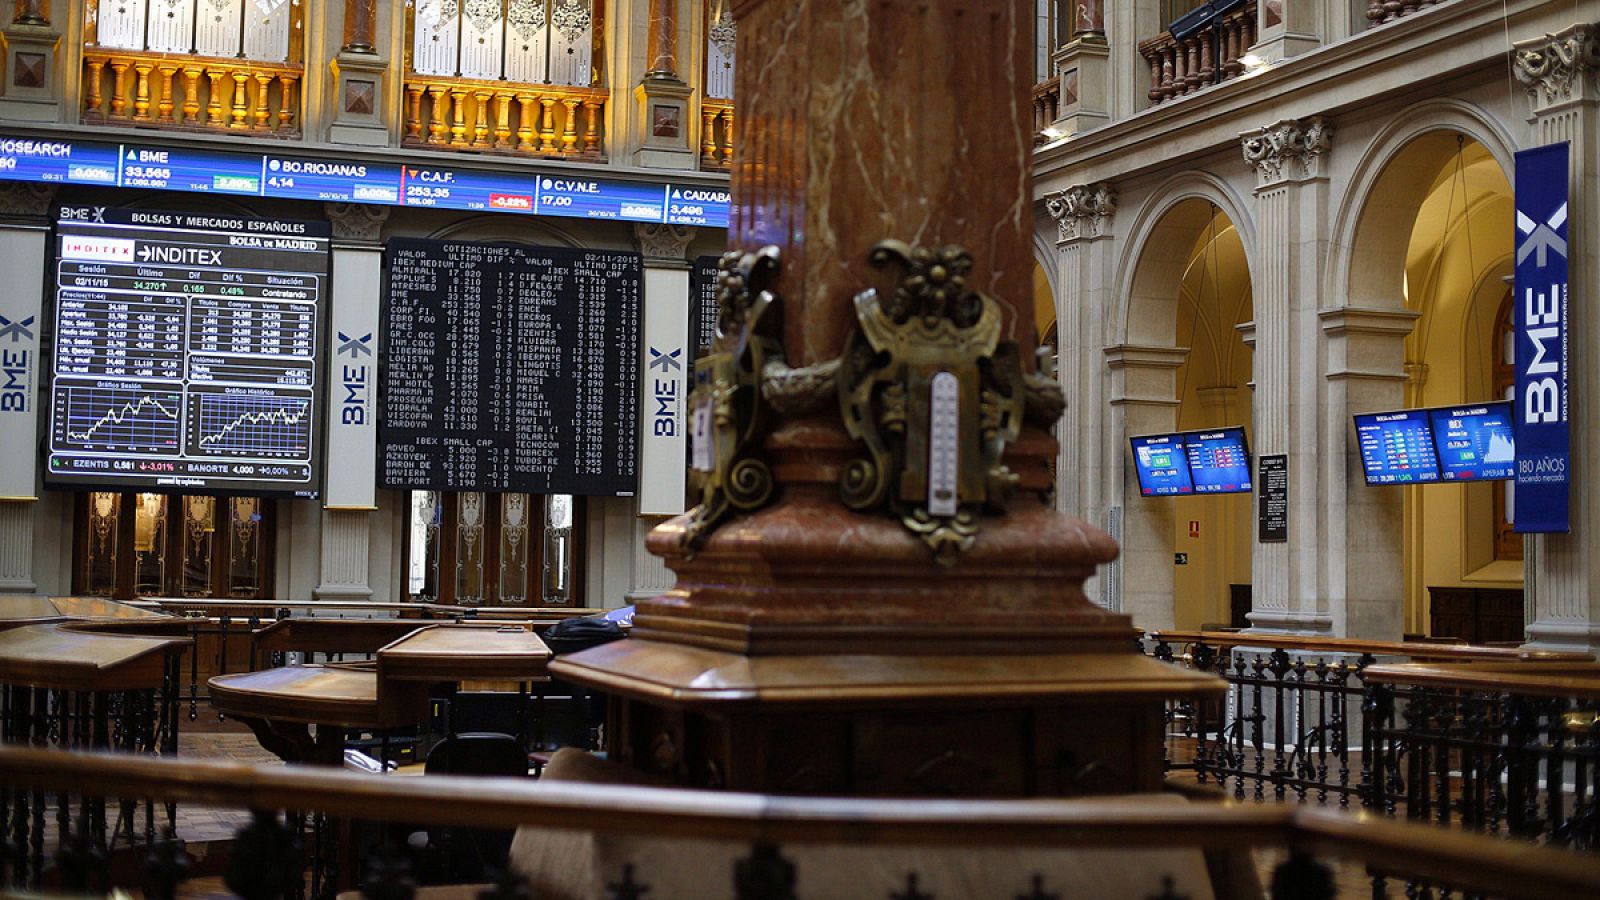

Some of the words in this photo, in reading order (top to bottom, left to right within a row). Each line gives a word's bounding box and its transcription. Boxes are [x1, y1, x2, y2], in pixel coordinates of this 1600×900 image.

[140, 150, 168, 163] BME
[282, 160, 367, 178] BO.RIOJANAS
[268, 176, 294, 188] 4,14
[420, 171, 456, 184] C.A.F.
[555, 180, 600, 194] C.V.N.E.
[541, 196, 572, 207] 17,00
[60, 208, 89, 220] BME
[131, 213, 171, 225] BOLSAS
[176, 216, 182, 225] Y
[186, 216, 244, 230] MERCADOS
[248, 219, 305, 234] ESPAÑOLES
[229, 236, 261, 247] BOLSA
[276, 239, 317, 250] MADRID
[67, 244, 129, 255] INDITEX
[443, 244, 510, 256] COTIZACIONES
[151, 246, 222, 265] INDITEX
[398, 250, 426, 258] VALOR
[448, 253, 482, 262] ULTIMO
[487, 256, 503, 264] DIF
[459, 262, 476, 270] CAP
[524, 258, 553, 266] VALOR
[574, 260, 606, 270] ULTIMO
[612, 263, 628, 272] DIF
[392, 266, 436, 275] ALMIRALL
[574, 268, 601, 277] SMALL
[606, 271, 622, 279] CAP
[391, 275, 425, 283] APPLUS
[391, 283, 436, 291] ATRESMED
[262, 288, 307, 299] Contratando
[519, 305, 540, 313] ENCE
[518, 313, 551, 321] ERCROS
[390, 323, 412, 331] FAES
[518, 321, 551, 329] EUROPA
[518, 329, 556, 338] EZENTIS
[518, 337, 556, 346] FLUIDRA
[1525, 284, 1559, 423] BME
[389, 356, 428, 364] LOGISTA
[1, 349, 27, 412] BME
[388, 388, 421, 396] PHARMA
[517, 385, 538, 393] PRIM
[342, 365, 365, 425] BME
[516, 393, 544, 401] PRISA
[388, 396, 432, 404] PROSEGUR
[388, 404, 427, 412] VIDRALA
[655, 379, 675, 437] BME
[387, 412, 432, 421] VISCOFAN
[387, 420, 426, 428] ZARDOYA
[415, 437, 438, 445] IBEX
[443, 438, 470, 446] SMALL
[476, 439, 493, 447] CAP
[515, 441, 559, 449] TECNOCOM
[386, 453, 425, 461] AZKOYEN
[73, 459, 109, 469] EZENTIS
[187, 463, 229, 473] BANORTE
[386, 461, 414, 469] BARON
[515, 465, 553, 473] VOCENTO
[1519, 460, 1534, 473] 180
[1536, 456, 1565, 472] AÑOS
[386, 469, 425, 477] BAVIERA
